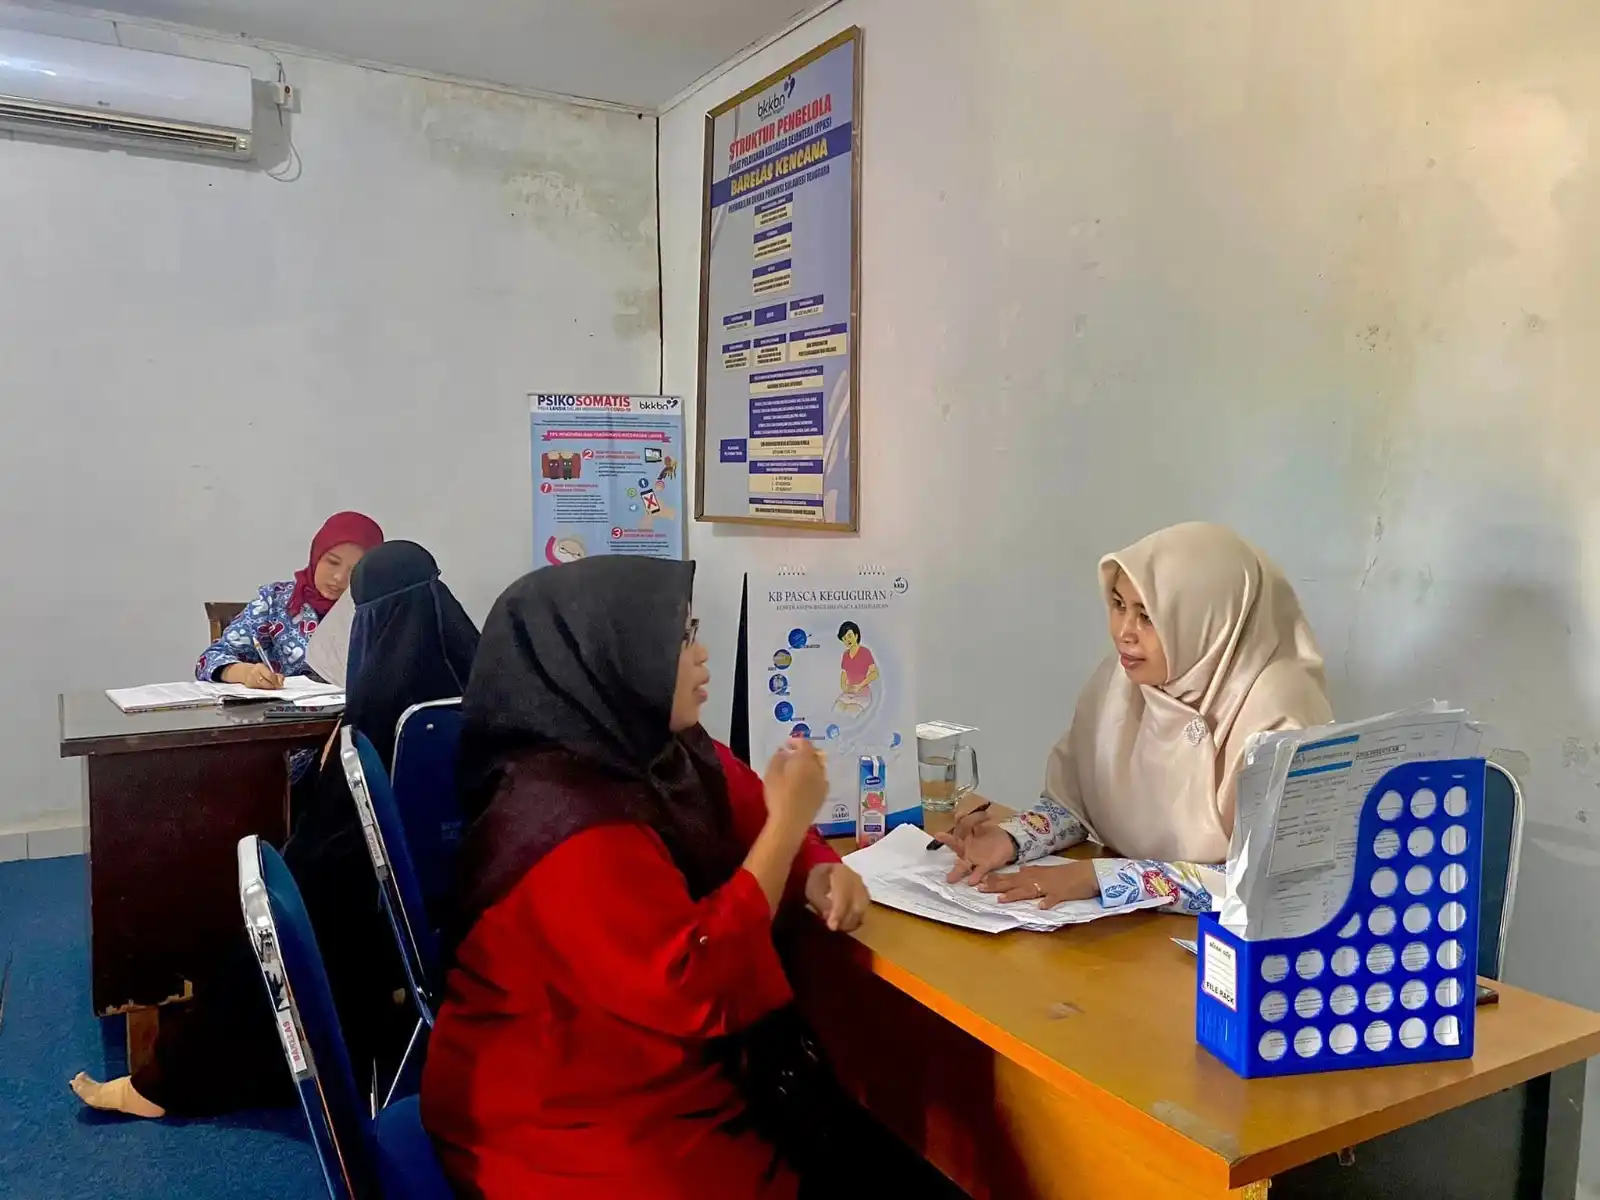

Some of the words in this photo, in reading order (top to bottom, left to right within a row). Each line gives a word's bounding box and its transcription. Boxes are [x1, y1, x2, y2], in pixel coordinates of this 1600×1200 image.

[757, 93, 786, 118] bkkbn
[729, 122, 776, 161] STRUKTUR
[777, 94, 832, 137] PENGELOLA
[731, 162, 773, 197] BARELAS
[775, 137, 828, 177] KENCANA
[537, 395, 631, 408] PSIKOSOMATIS
[639, 400, 669, 410] bkkbn
[768, 591, 783, 602] KB
[785, 591, 817, 602] PASCA
[819, 590, 887, 602] KEGUGURAN
[1206, 981, 1219, 994] FILE
